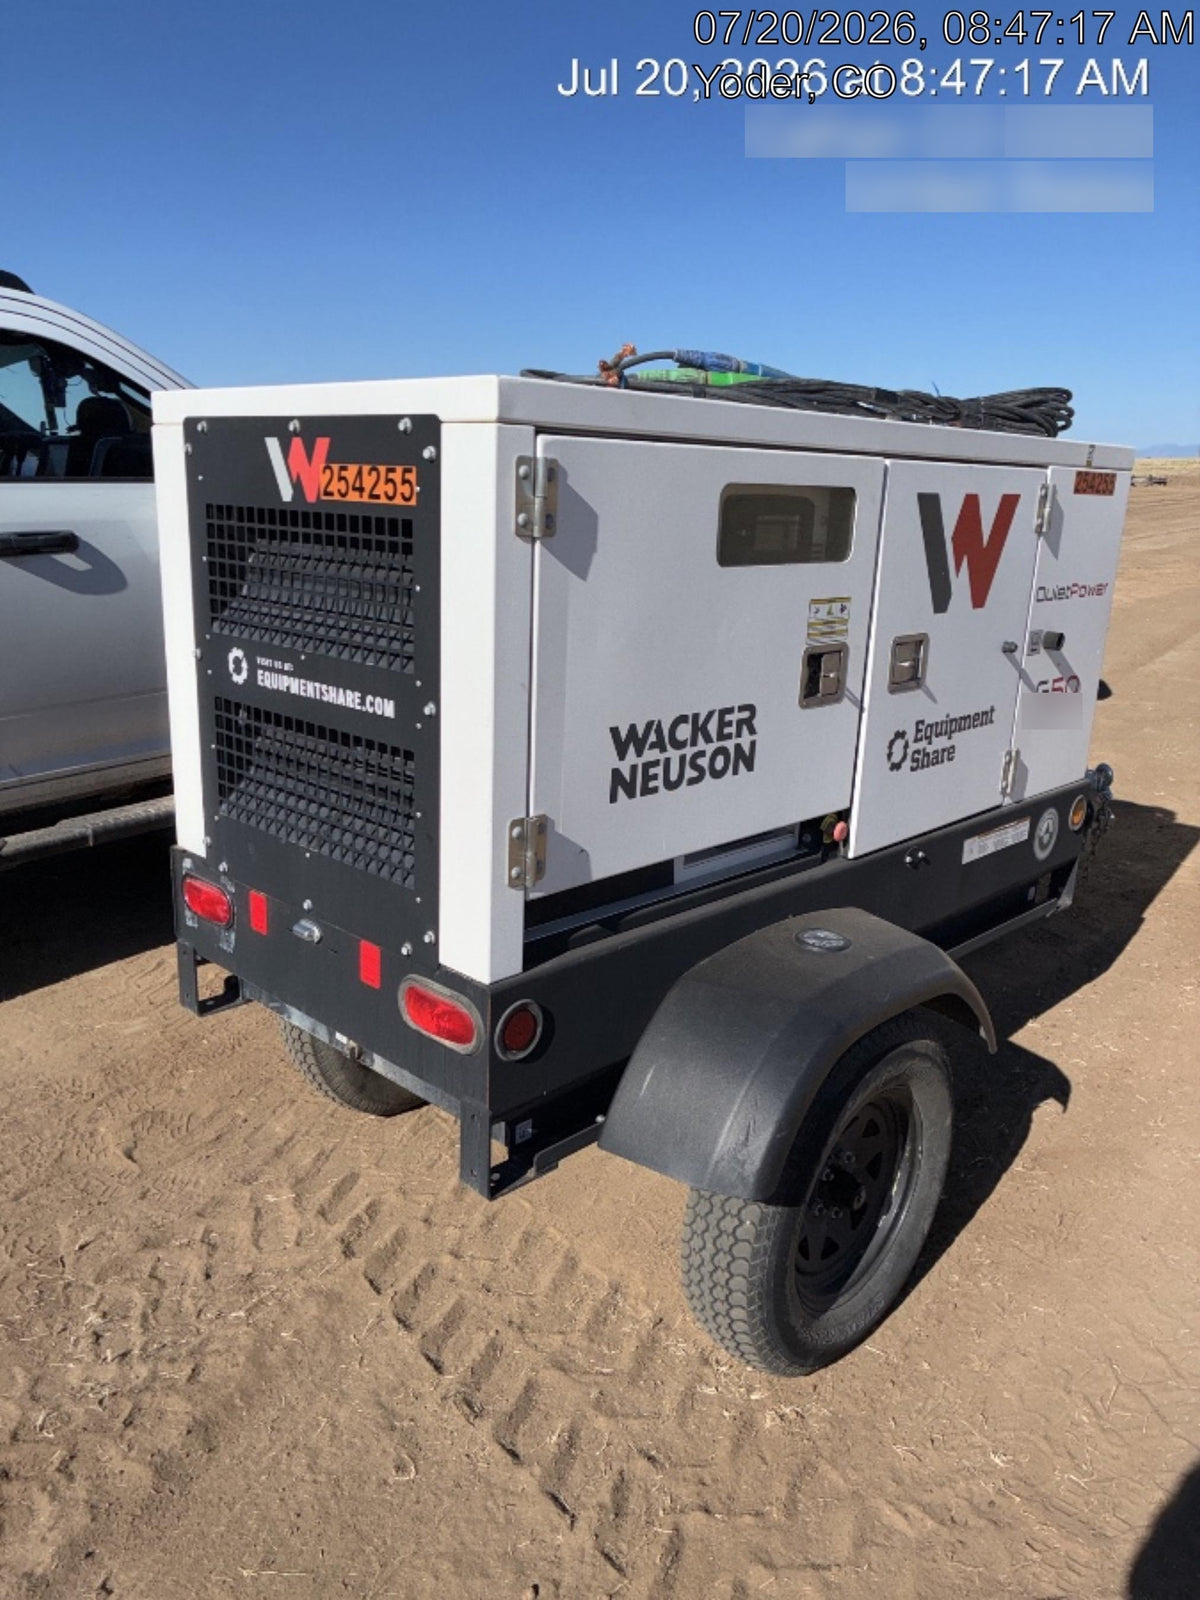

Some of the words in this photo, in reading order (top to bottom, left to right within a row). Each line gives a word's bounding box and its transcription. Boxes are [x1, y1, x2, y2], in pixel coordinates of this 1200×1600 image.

[322, 465, 414, 503] 254255
[256, 669, 395, 718] EQUIPMENTSHARE.COM
[609, 703, 758, 761] WACKER
[913, 705, 995, 745] Equipment
[609, 739, 757, 804] NEUSON
[910, 744, 956, 772] Share
